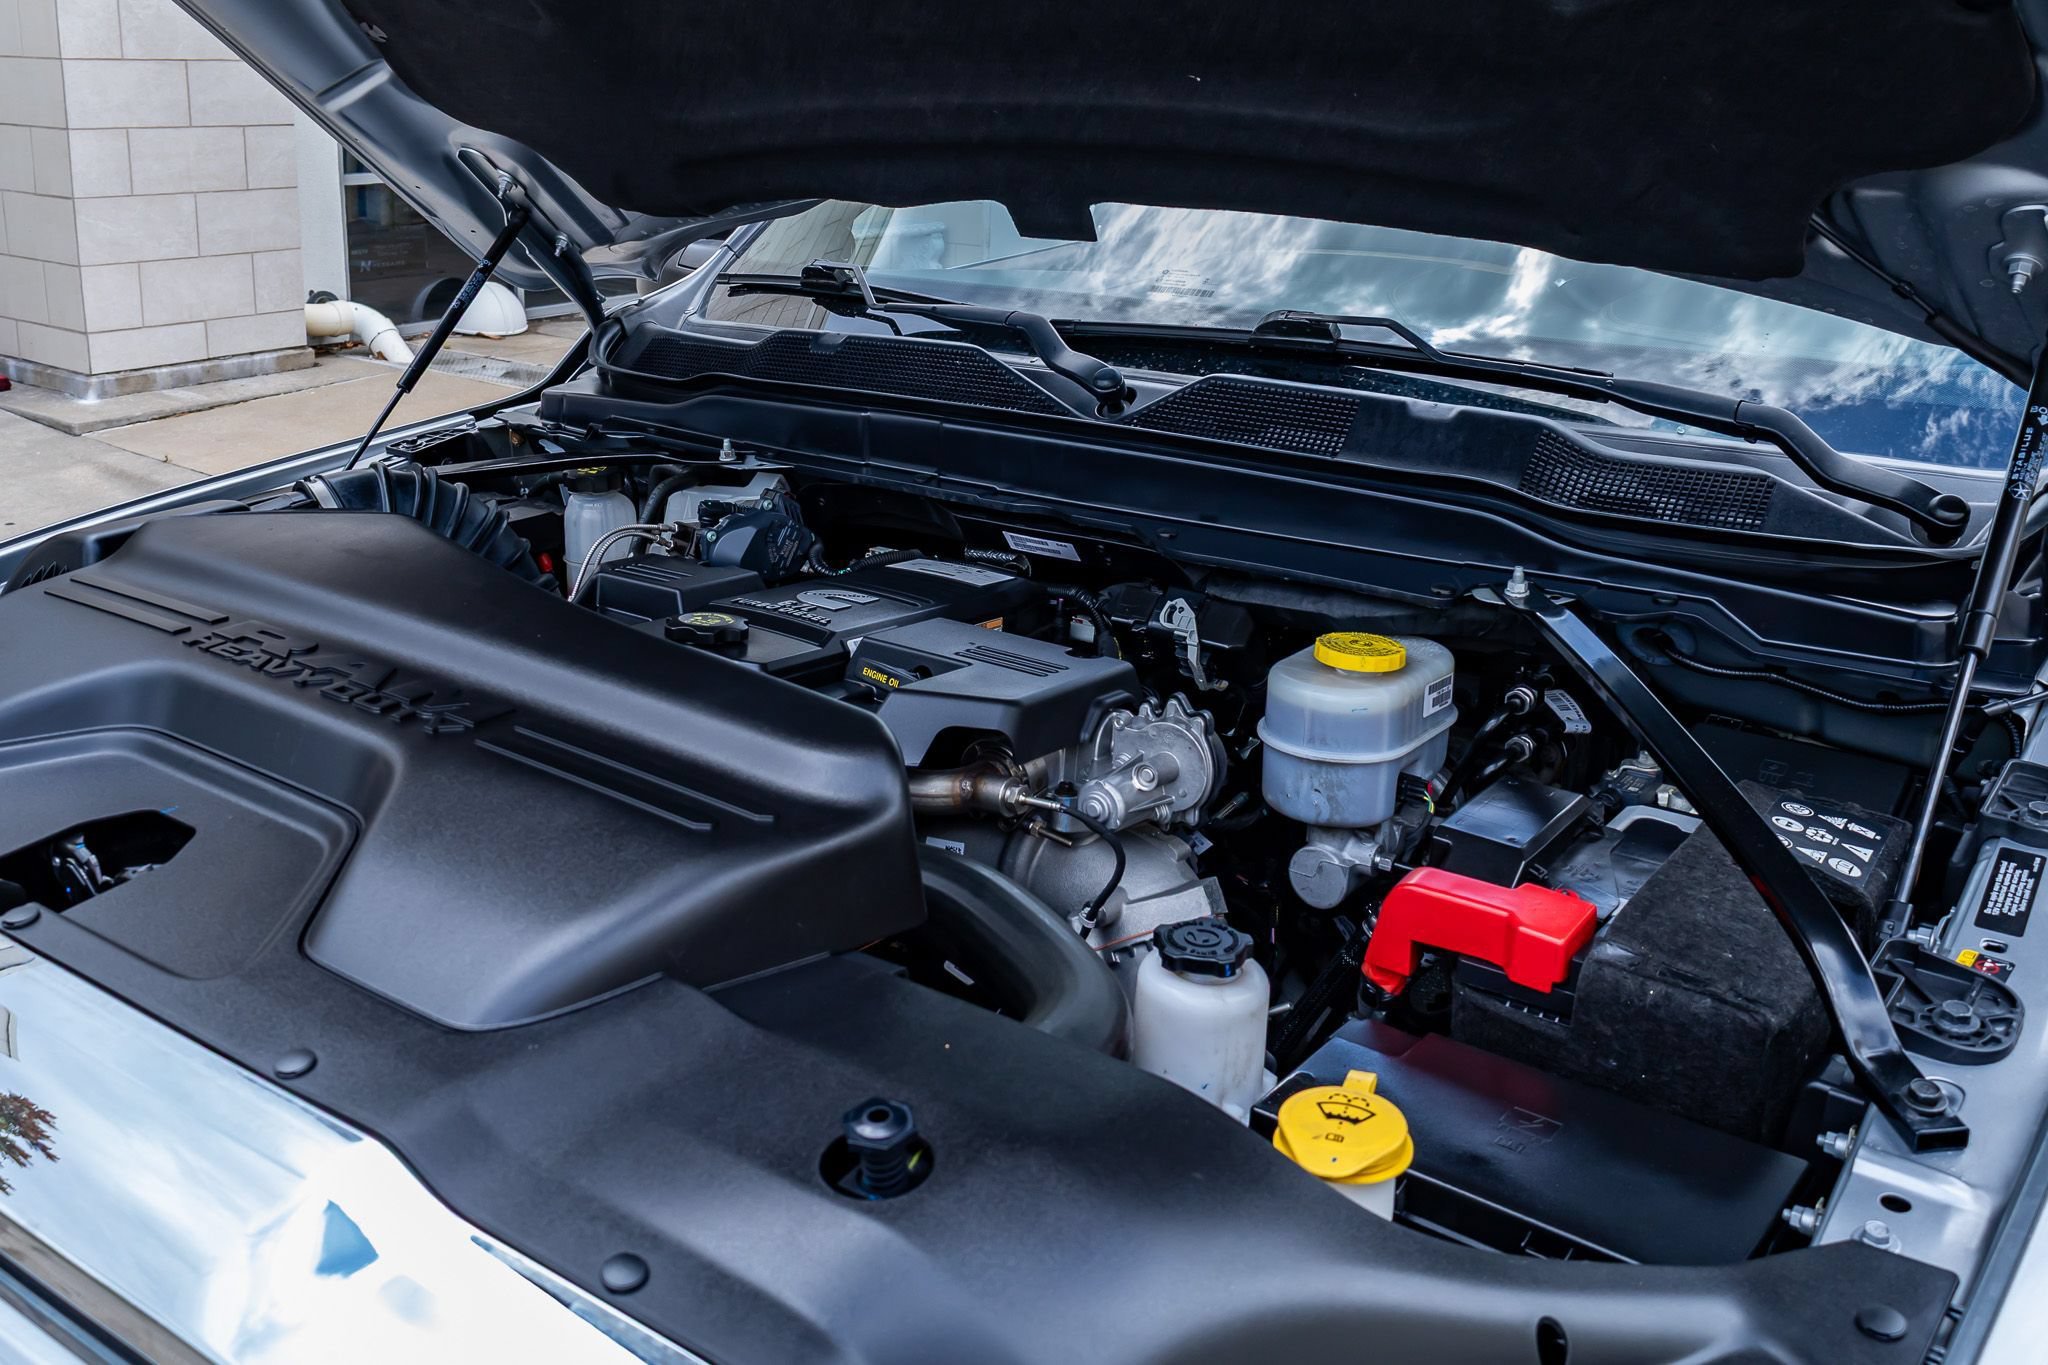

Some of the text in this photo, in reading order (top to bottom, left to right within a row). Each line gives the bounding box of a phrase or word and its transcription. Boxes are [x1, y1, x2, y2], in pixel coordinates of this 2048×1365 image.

[2011, 427, 2033, 480] STABILUS
[730, 597, 832, 626] TURBO DIESEL
[183, 634, 333, 688] HEAVY
[862, 667, 888, 684] ENGINE
